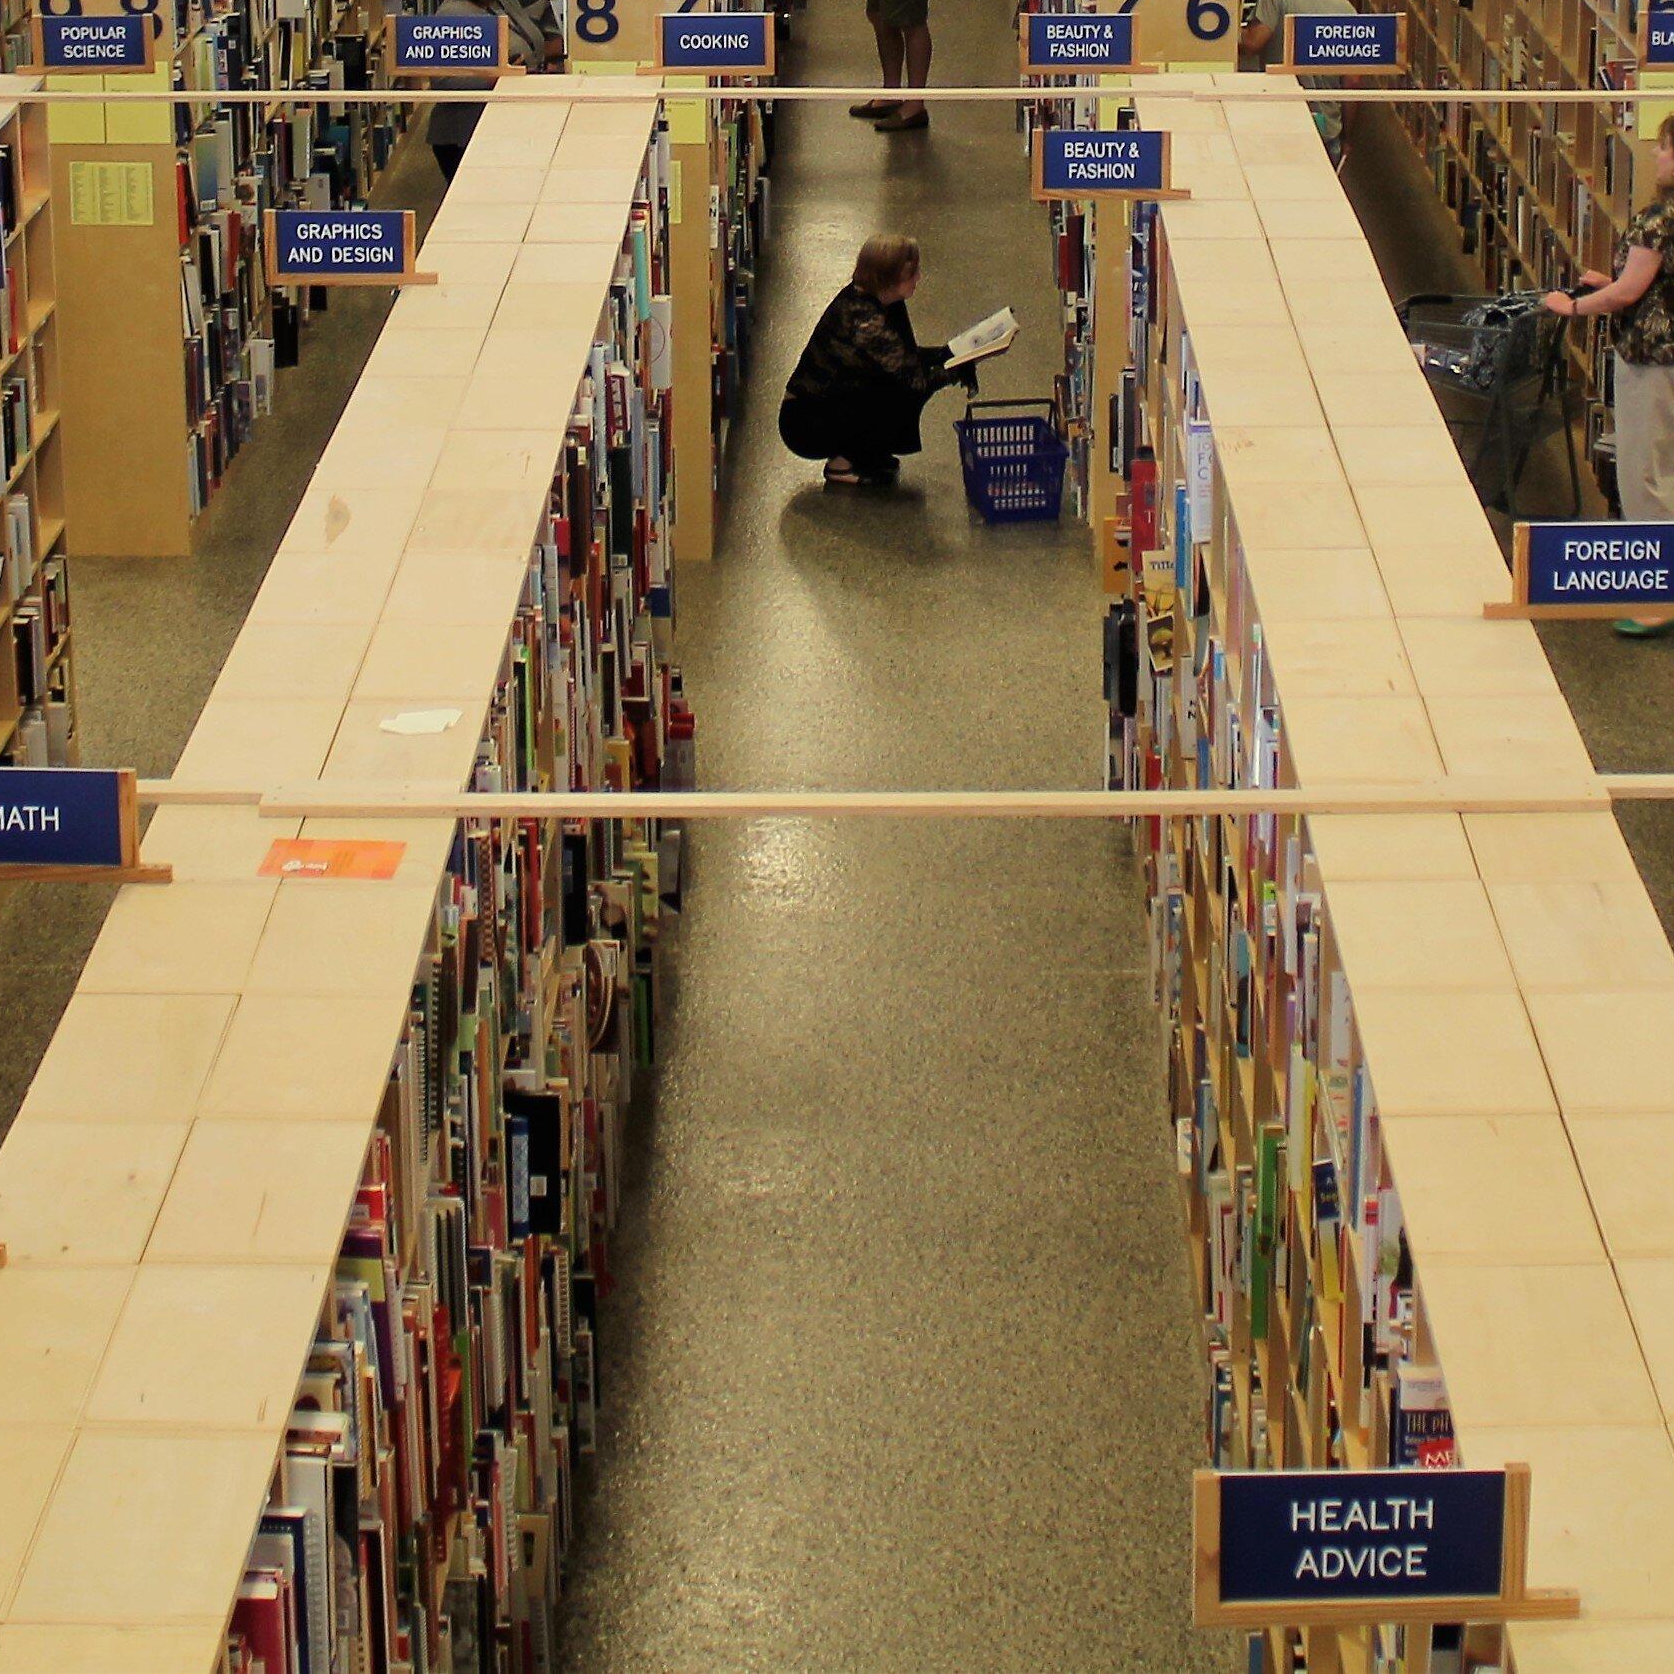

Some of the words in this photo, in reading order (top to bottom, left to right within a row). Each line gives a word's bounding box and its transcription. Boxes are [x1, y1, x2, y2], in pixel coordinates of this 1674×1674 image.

[60, 26, 126, 41] POPULAR
[412, 25, 483, 40] GRAPHICS
[1046, 24, 1101, 40] BEAUTY
[1103, 24, 1114, 40] &
[1315, 24, 1376, 39] FOREIGN
[679, 33, 749, 50] COOKING
[1049, 42, 1110, 58] FASHION
[63, 44, 126, 59] SCIENCE
[405, 44, 435, 59] AND
[440, 44, 491, 59] DESIGN
[1308, 43, 1381, 58] LANGUAGE
[1064, 141, 1126, 159] BEAUTY
[1128, 141, 1140, 159] &
[1068, 162, 1135, 180] FASHION
[296, 223, 383, 240] GRAPHICS
[287, 246, 324, 263] AND
[331, 246, 394, 263] DESIGN
[1564, 540, 1661, 561] FOREIGN
[1553, 569, 1669, 591] LANGUAGE
[1291, 1498, 1434, 1532] HEALTH
[1295, 1545, 1428, 1579] ADVICE
